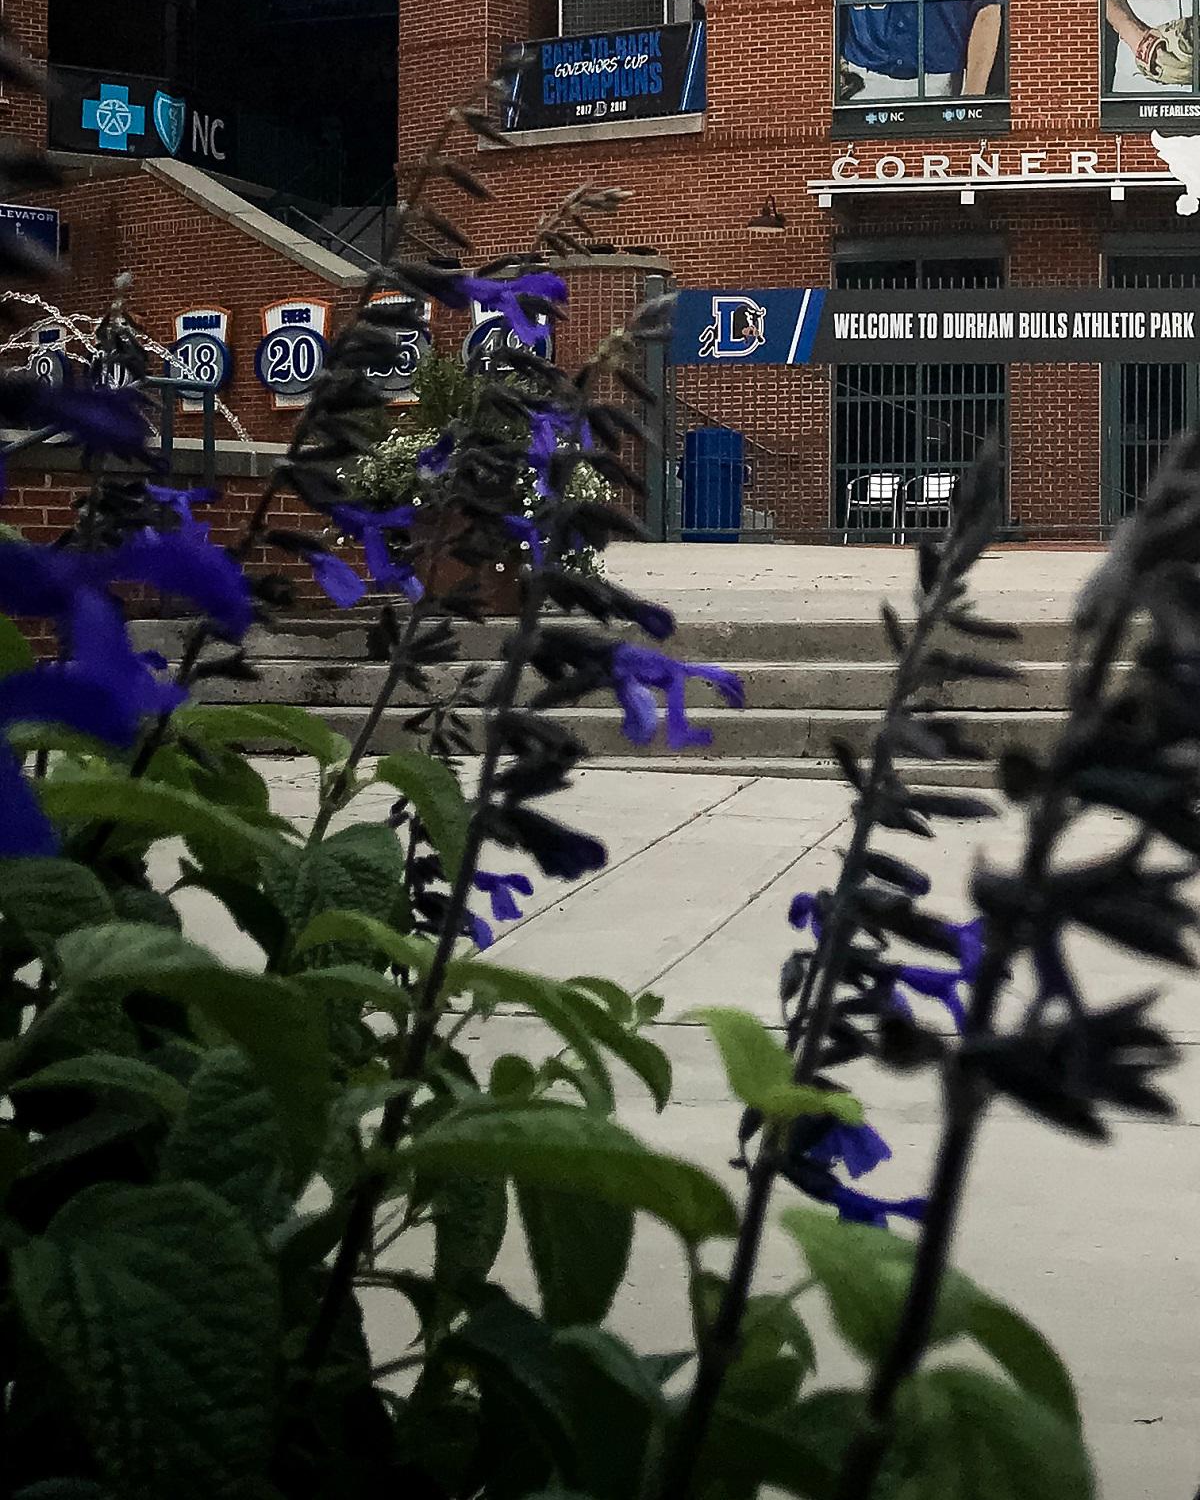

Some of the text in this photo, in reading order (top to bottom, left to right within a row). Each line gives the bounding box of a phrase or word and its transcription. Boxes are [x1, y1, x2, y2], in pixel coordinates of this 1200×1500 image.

[555, 54, 649, 78] GOVERNORS' CUP
[543, 62, 663, 105] CHAMPIONS
[890, 112, 904, 121] NC
[968, 109, 982, 118] NC
[1140, 105, 1158, 117] LIVE
[192, 111, 226, 160] NC
[832, 151, 1099, 180] CORNER
[0, 208, 54, 221] LEVATOR
[834, 312, 1195, 339] WELCOME TO DURHAM BULLS ATHLETIC PARK
[177, 343, 217, 383] 18
[267, 335, 317, 382] 20
